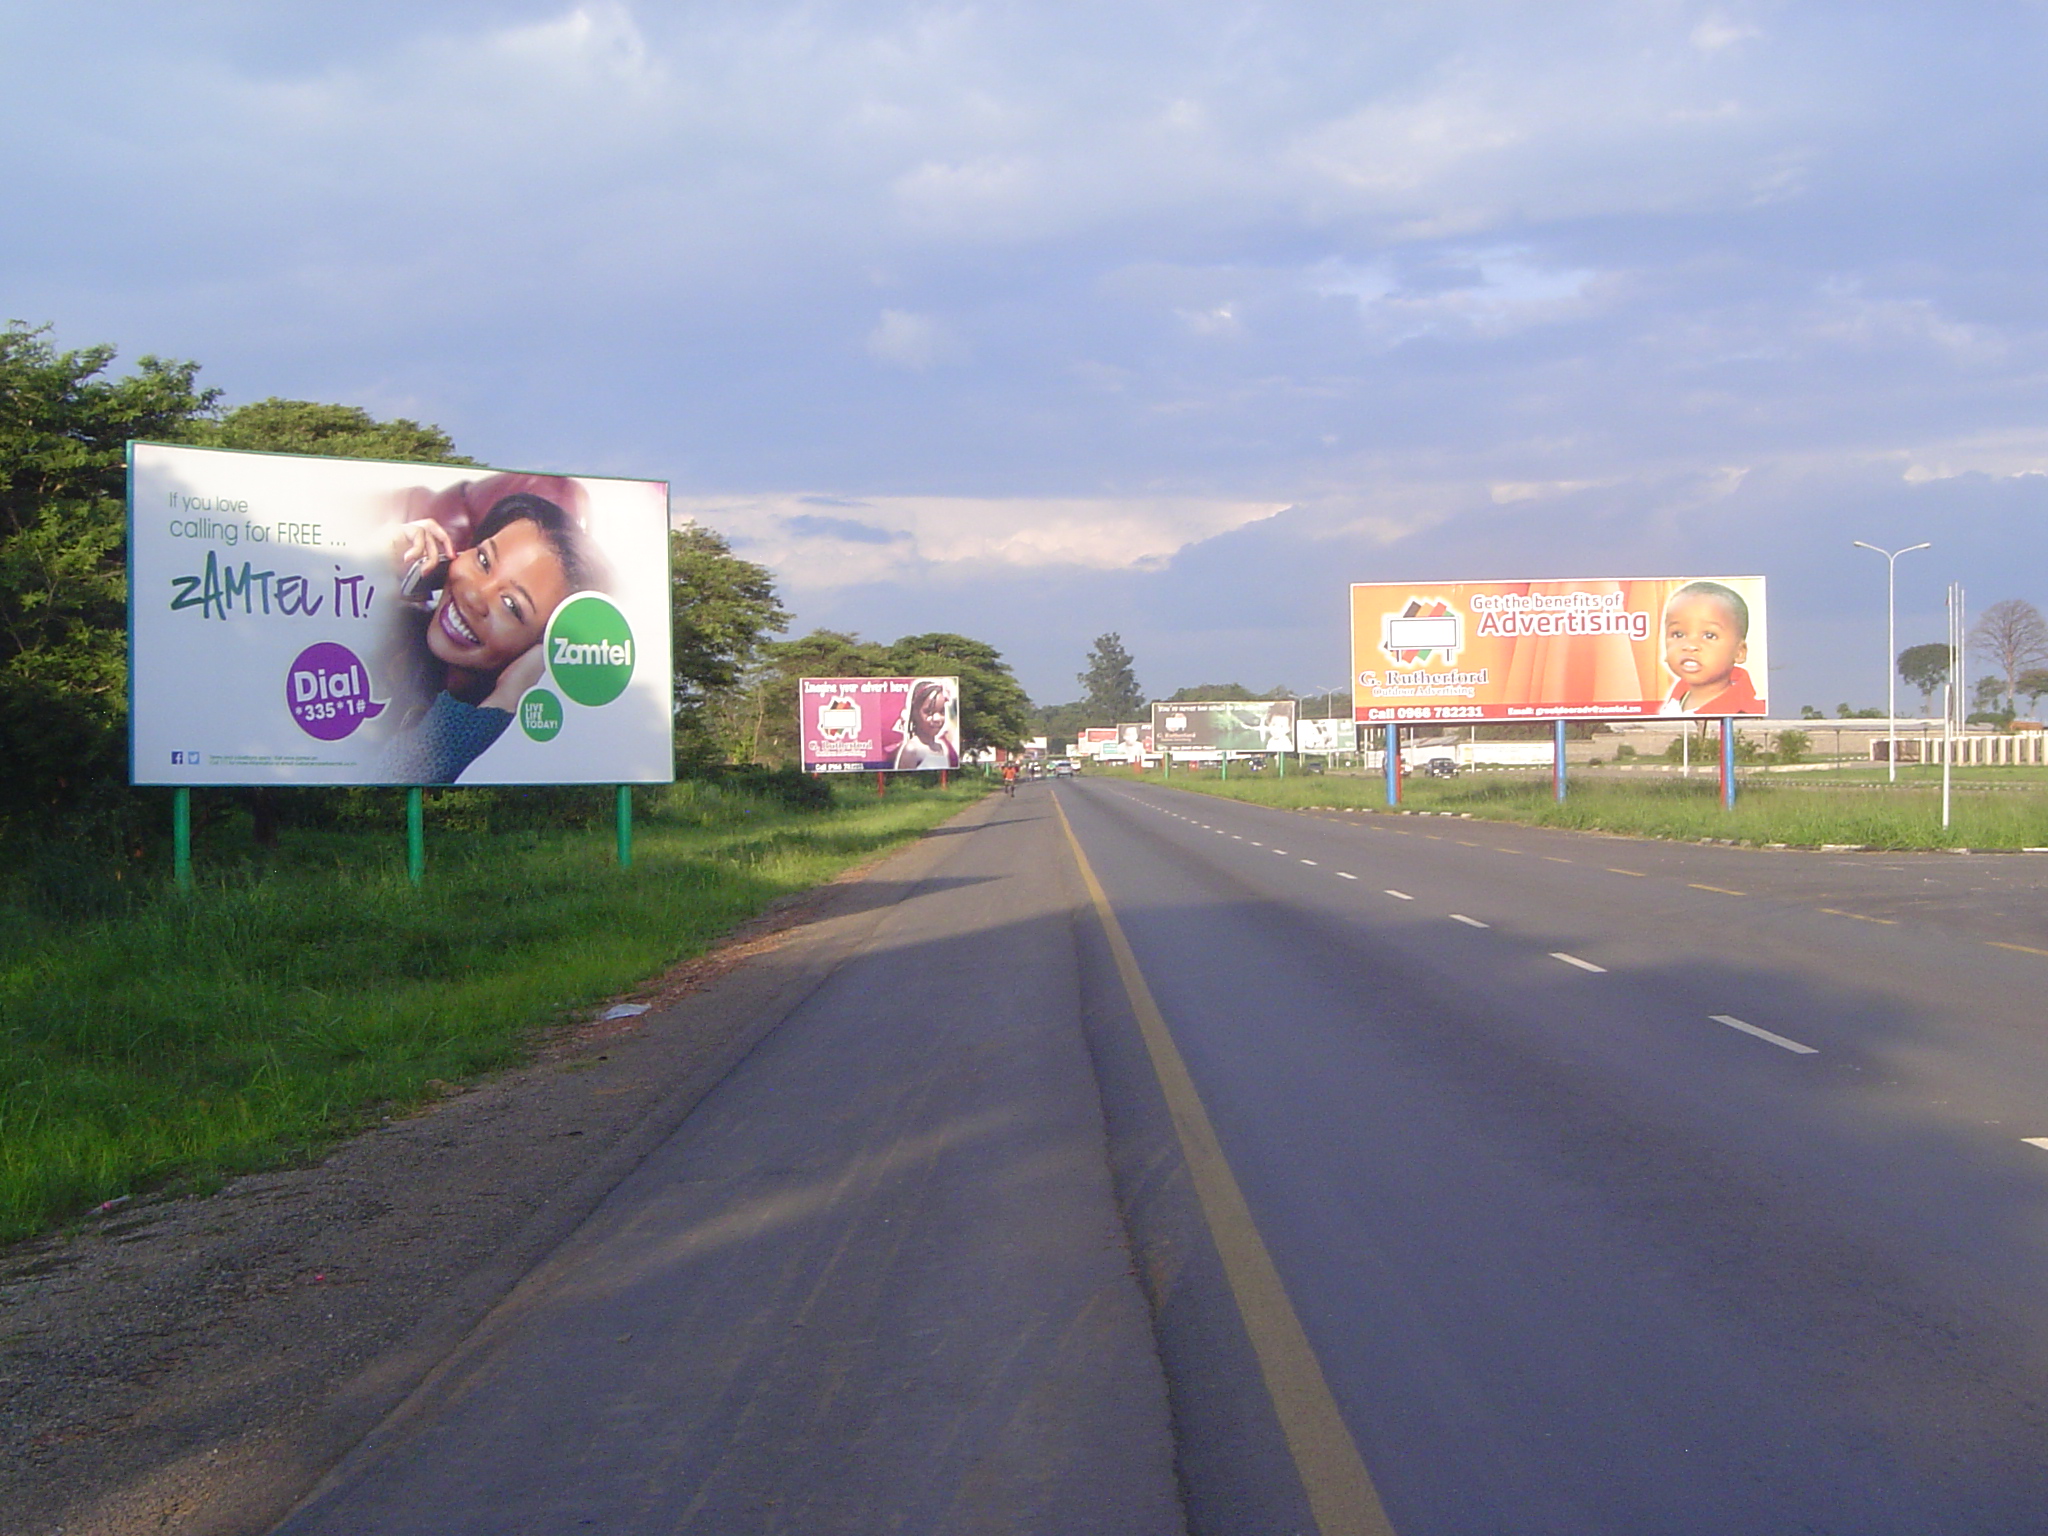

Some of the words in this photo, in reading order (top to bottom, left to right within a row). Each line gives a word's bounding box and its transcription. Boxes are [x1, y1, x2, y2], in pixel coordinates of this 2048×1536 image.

[169, 491, 179, 508] If
[182, 495, 211, 513] you
[215, 496, 249, 513] love
[169, 517, 238, 547] calling
[245, 520, 271, 543] for
[276, 521, 323, 546] FREE
[1472, 596, 1500, 610] Get
[1504, 595, 1530, 609] the
[1534, 594, 1600, 609] benefits
[1604, 593, 1621, 607] of
[1480, 609, 1648, 638] Advertising
[553, 637, 631, 666] Zamtel
[294, 664, 360, 702] Dial
[1359, 670, 1382, 687] G.
[1386, 668, 1489, 685] Rutherford
[1373, 686, 1415, 697] Outdoor
[1416, 685, 1475, 698] Advertising
[525, 703, 544, 712] LIVE
[525, 711, 542, 720] LIFE
[1368, 708, 1395, 719] Call
[525, 720, 558, 729] TODAY!
